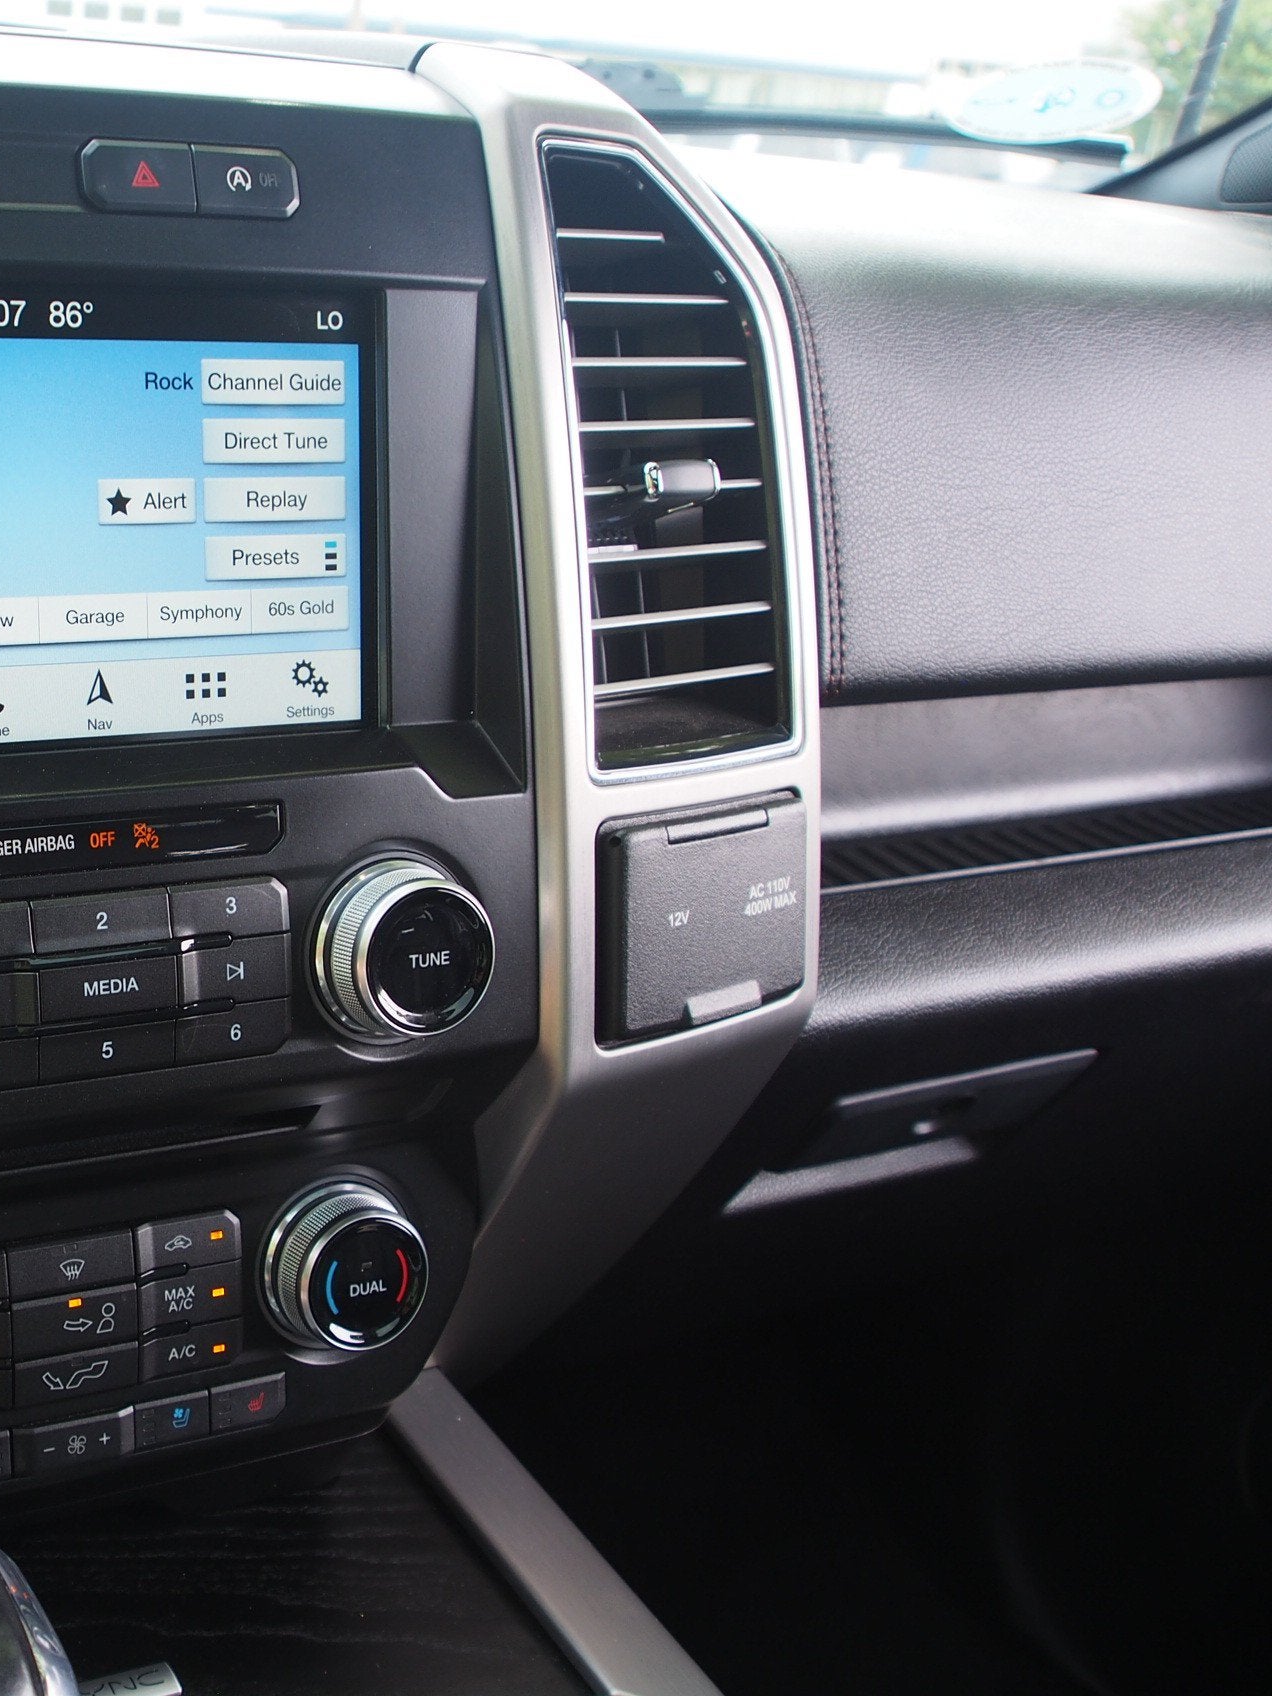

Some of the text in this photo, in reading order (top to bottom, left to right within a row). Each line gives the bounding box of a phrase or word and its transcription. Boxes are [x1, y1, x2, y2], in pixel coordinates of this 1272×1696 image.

[48, 300, 94, 328] 86°
[316, 310, 344, 330] LO
[144, 371, 194, 391] Rock
[207, 372, 342, 392] Channel Guide
[224, 431, 328, 450] Direct Tune
[143, 491, 188, 510] Alert
[246, 490, 308, 511] Replay
[232, 548, 300, 566] Presets
[65, 609, 125, 627] Garage
[159, 604, 243, 624] Symphony
[268, 600, 335, 617] 60s Gold
[191, 711, 224, 726] Apps
[286, 704, 335, 719] Settings
[87, 718, 113, 731] Nav
[25, 834, 75, 854] AIRBAG
[90, 831, 116, 849] OFF
[749, 876, 791, 899] AC 110V
[225, 896, 237, 915] 3
[743, 890, 798, 916] 400W MAX
[96, 911, 108, 930] 2
[668, 909, 690, 928] 12V
[408, 950, 450, 969] TUNE
[83, 977, 139, 997] MEDIA
[230, 1023, 242, 1042] 6
[101, 1041, 114, 1059] 5
[164, 1285, 195, 1302] MAX
[349, 1279, 387, 1298] DUAL
[168, 1298, 193, 1313] A/C
[168, 1344, 196, 1361] A/C
